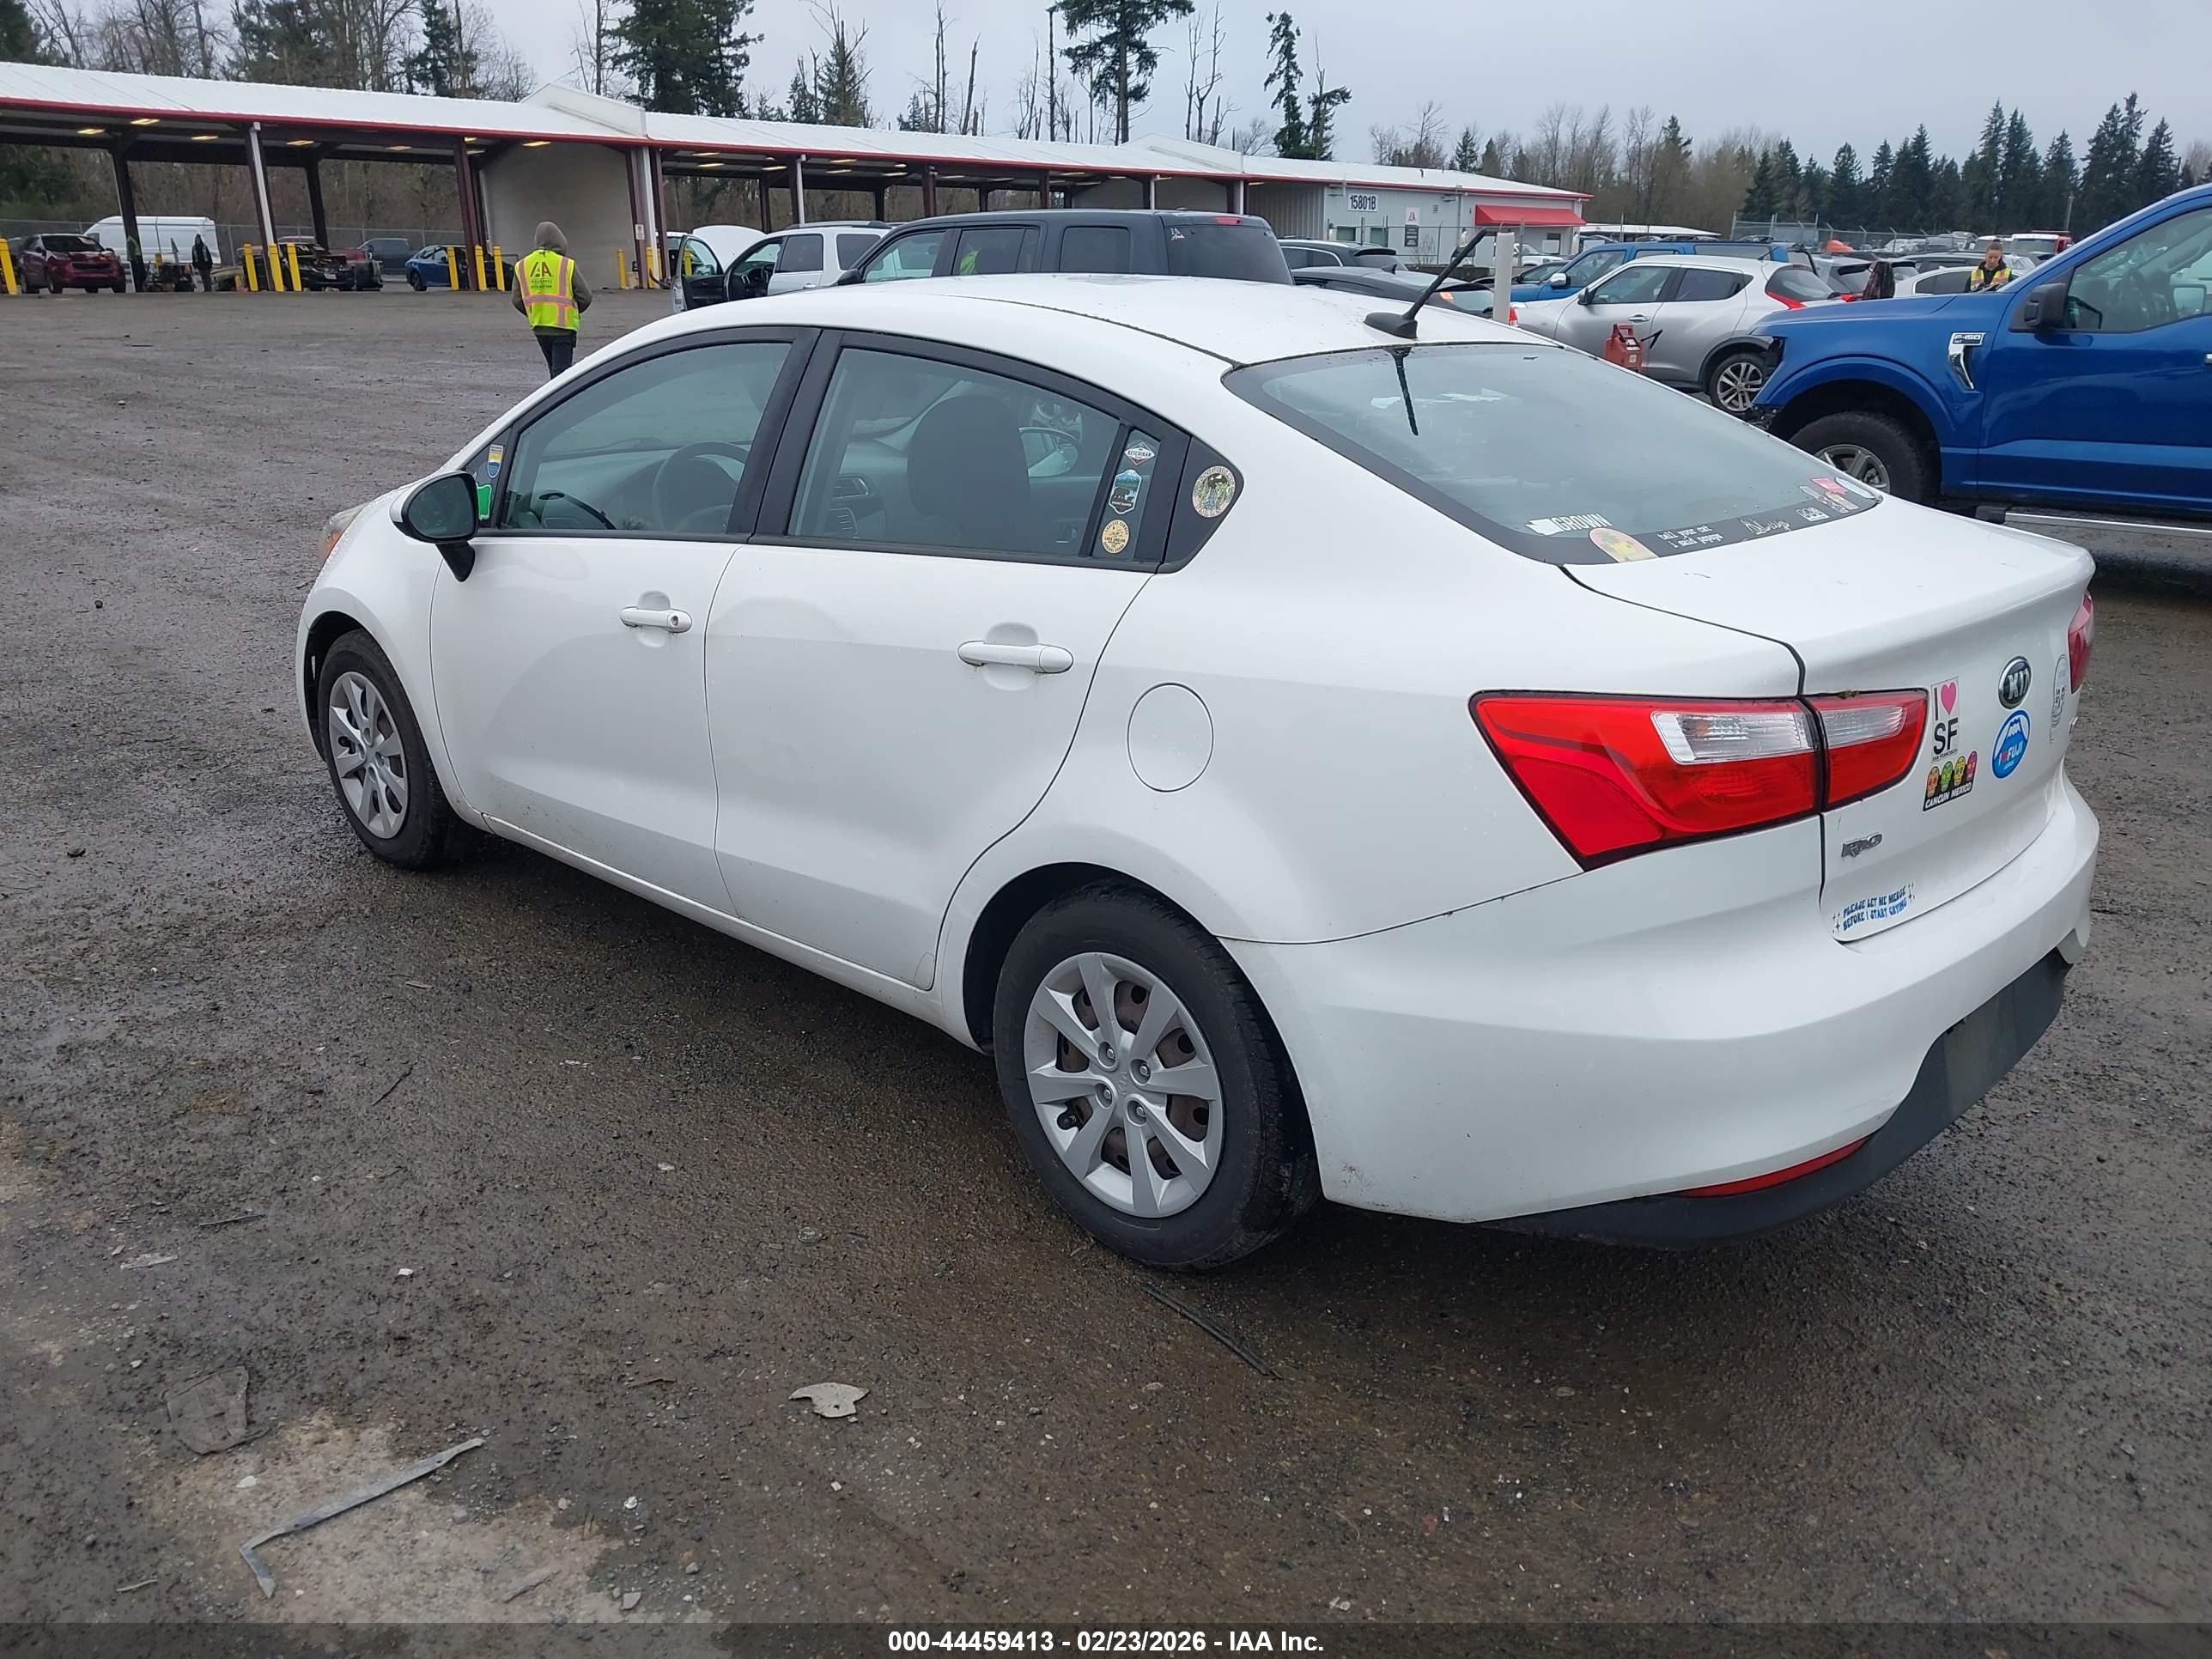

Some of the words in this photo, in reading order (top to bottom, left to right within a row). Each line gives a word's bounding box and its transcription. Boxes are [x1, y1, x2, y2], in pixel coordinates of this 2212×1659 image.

[1349, 194, 1376, 210] 15801B
[1550, 513, 1613, 532] GROWN
[1934, 687, 1939, 721] I
[1933, 717, 1959, 756] SF
[2007, 740, 2024, 763] FUJI
[1924, 791, 1950, 809] CANCUN
[1950, 781, 1972, 798] MEXICO
[1843, 899, 1866, 919] PLEASE
[1867, 896, 1878, 908] LET
[1878, 895, 1887, 906] ME
[1888, 885, 1906, 903] MERGE
[1843, 911, 1865, 932] BEFORE
[1869, 907, 1888, 920] START
